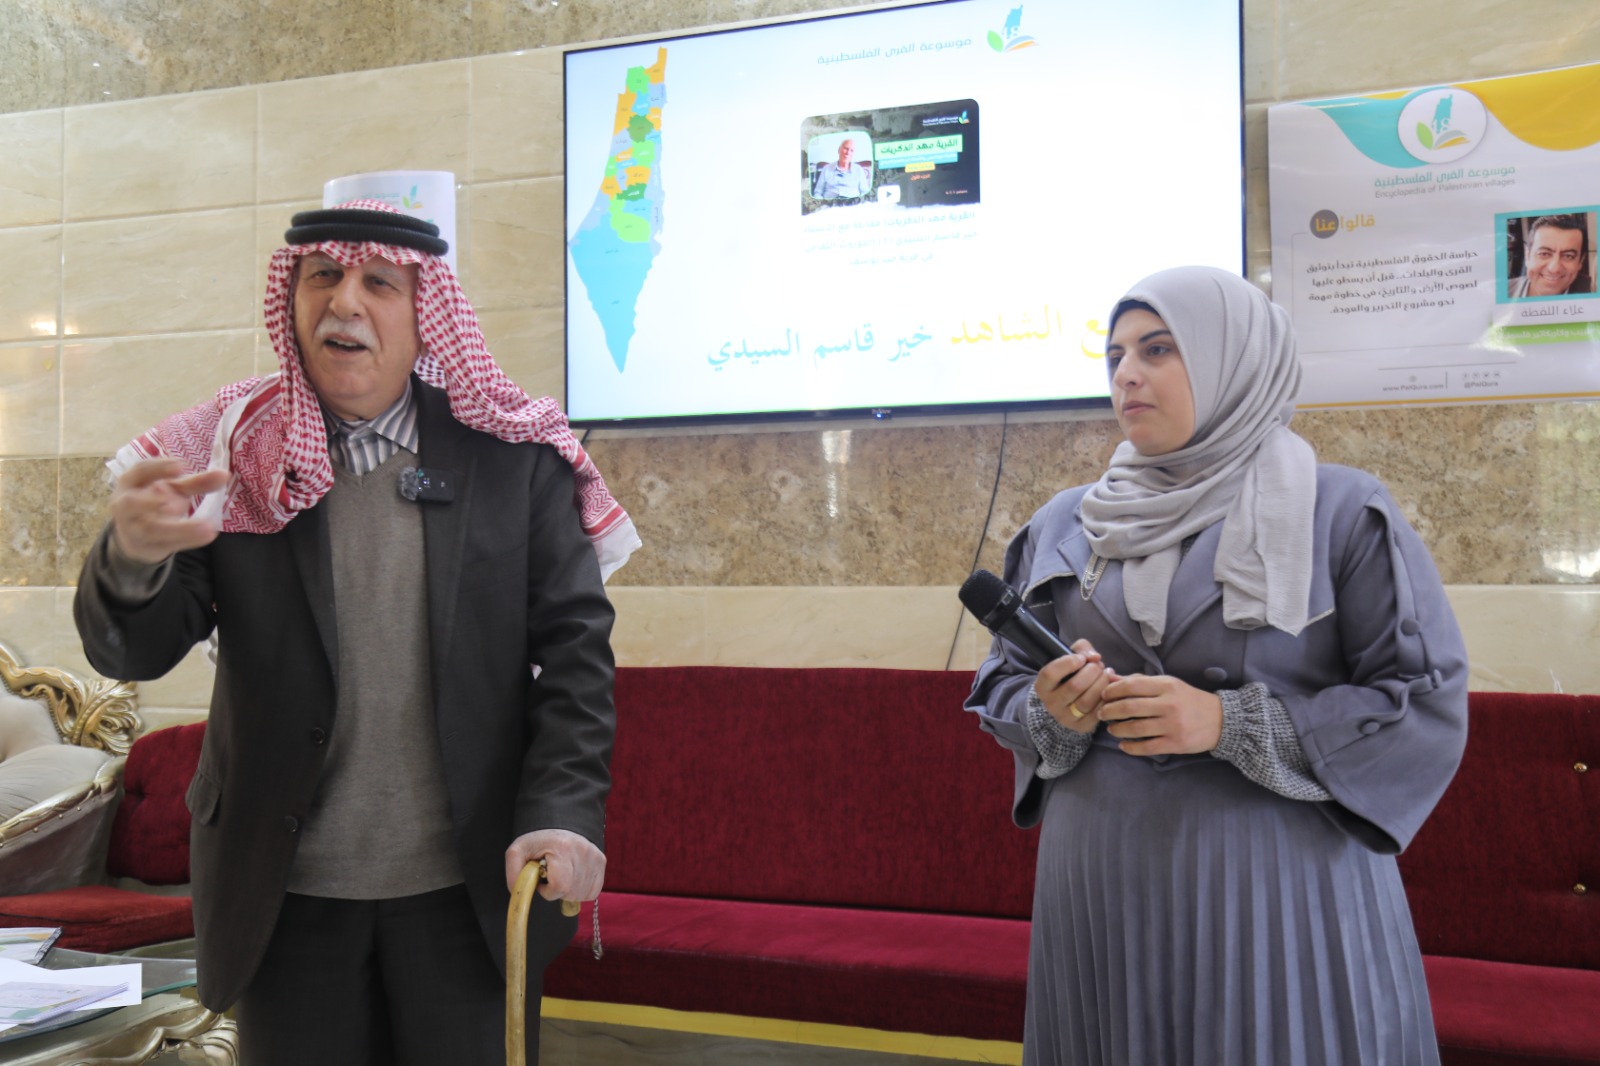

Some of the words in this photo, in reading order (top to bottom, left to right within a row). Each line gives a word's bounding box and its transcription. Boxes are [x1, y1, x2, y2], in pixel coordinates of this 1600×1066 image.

[919, 37, 972, 52] موسوعة
[817, 48, 880, 65] الفلسطينية
[1467, 165, 1516, 180] موسوعة
[1374, 171, 1433, 190] الفلسطينية
[1375, 187, 1426, 199] Encyclopedia
[1427, 184, 1436, 194] of
[1438, 182, 1482, 193] Palestinian
[1315, 216, 1337, 232] عنا
[1340, 213, 1376, 232] قالوا
[1411, 252, 1447, 265] الحقوق
[1449, 250, 1478, 260] حراسة
[1306, 262, 1335, 274] بتوثيق
[1356, 256, 1410, 269] الفلسطينية
[1365, 271, 1375, 283] أن
[1377, 272, 1395, 283] قبل
[1445, 265, 1472, 277] القرى
[1312, 277, 1334, 288] عليها
[1336, 276, 1364, 287] يسطو
[1445, 280, 1477, 292] لصوص
[1308, 293, 1332, 302] مهمة
[1334, 290, 1361, 301] خطوة
[1371, 301, 1402, 313] التحرير
[1403, 298, 1436, 312] مشروع
[1437, 297, 1455, 308] نحو
[1562, 304, 1585, 316] علاء
[951, 303, 1062, 344] الشاهد
[887, 321, 932, 362] خير
[1081, 318, 1109, 360] ع
[707, 327, 800, 372] السيدي
[814, 322, 874, 370] قاسم
